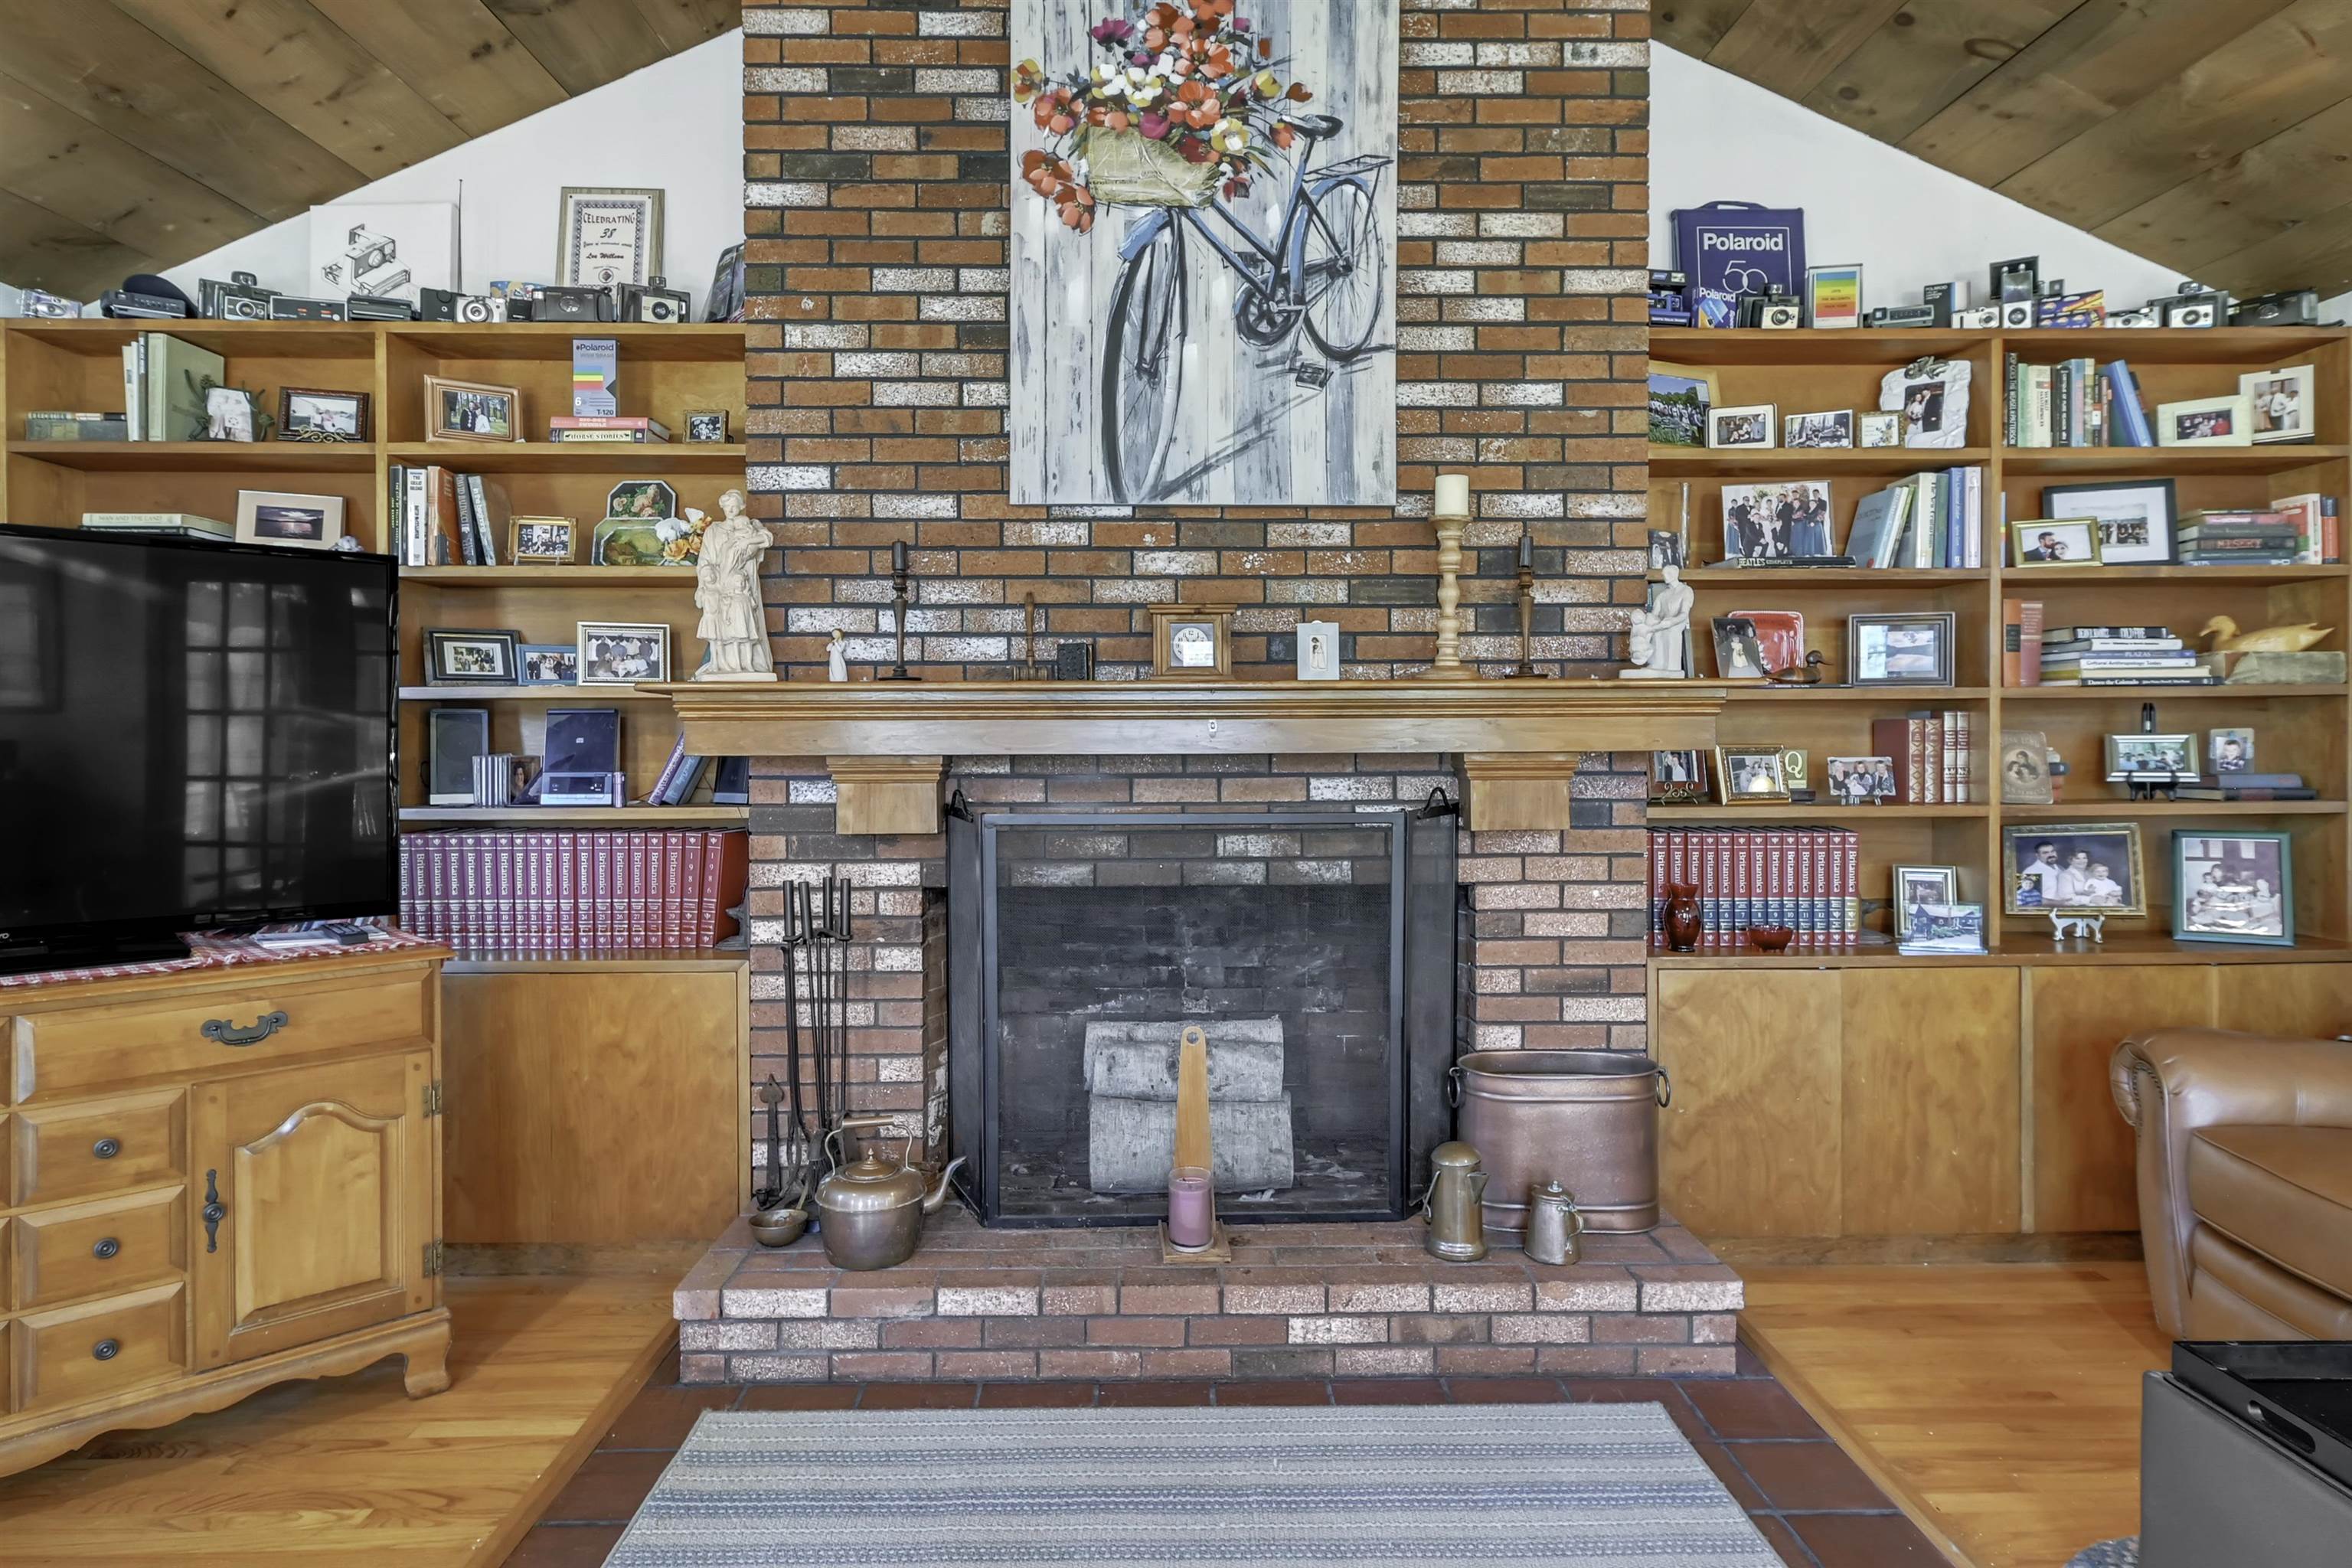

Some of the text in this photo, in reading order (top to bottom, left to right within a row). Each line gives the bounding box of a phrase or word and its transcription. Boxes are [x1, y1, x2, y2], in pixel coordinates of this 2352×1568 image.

[583, 212, 635, 224] CELEBRATING
[600, 228, 617, 238] 38
[1703, 233, 1783, 251] Polaroid
[1723, 260, 1768, 294] 50
[1699, 287, 1736, 302] Polaroid
[575, 397, 582, 406] 6
[456, 474, 468, 523] DAVID BALDACCI
[475, 505, 486, 533] beginning
[1739, 558, 1766, 567] BEATLES
[1785, 751, 1803, 779] Q
[451, 854, 459, 895] Britannica
